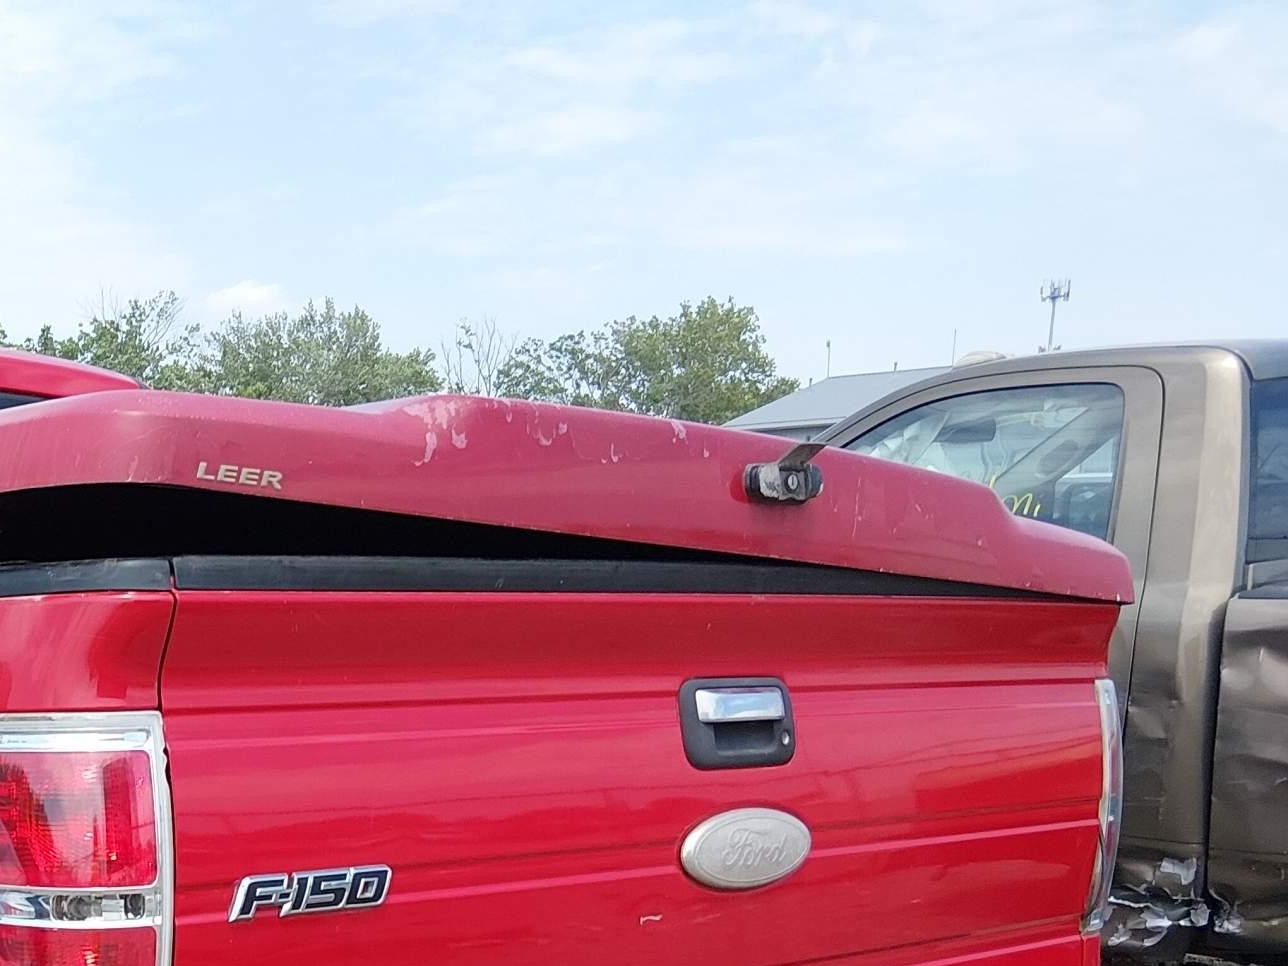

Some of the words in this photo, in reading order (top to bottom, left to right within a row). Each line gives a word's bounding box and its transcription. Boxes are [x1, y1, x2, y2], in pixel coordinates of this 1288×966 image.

[197, 461, 283, 490] LEER
[722, 828, 788, 867] Ford
[228, 864, 392, 923] F-150
